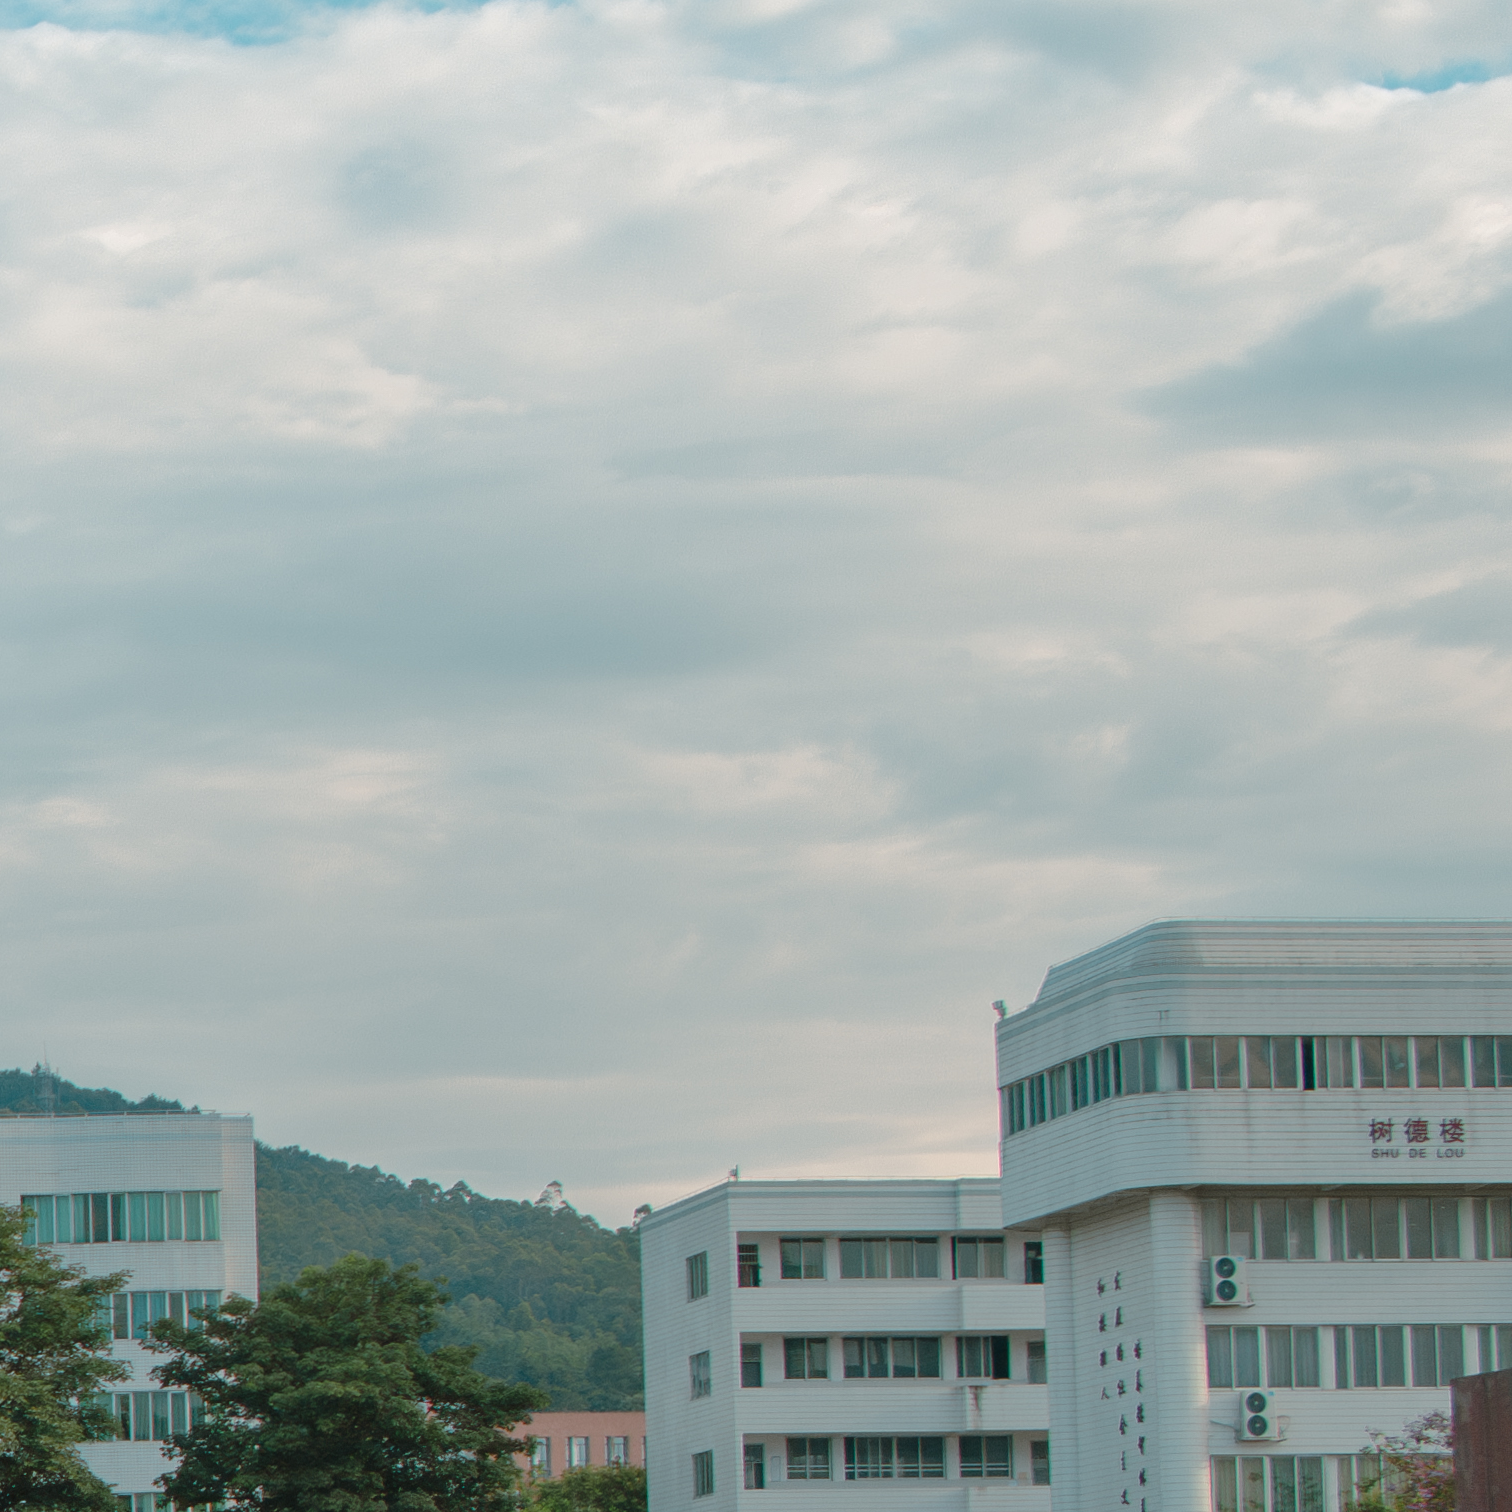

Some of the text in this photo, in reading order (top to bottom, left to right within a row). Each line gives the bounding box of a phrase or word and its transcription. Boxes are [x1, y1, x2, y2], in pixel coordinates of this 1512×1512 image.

[1369, 1117, 1465, 1143] 树德楼
[1371, 1148, 1465, 1158] SHU DE LOU
